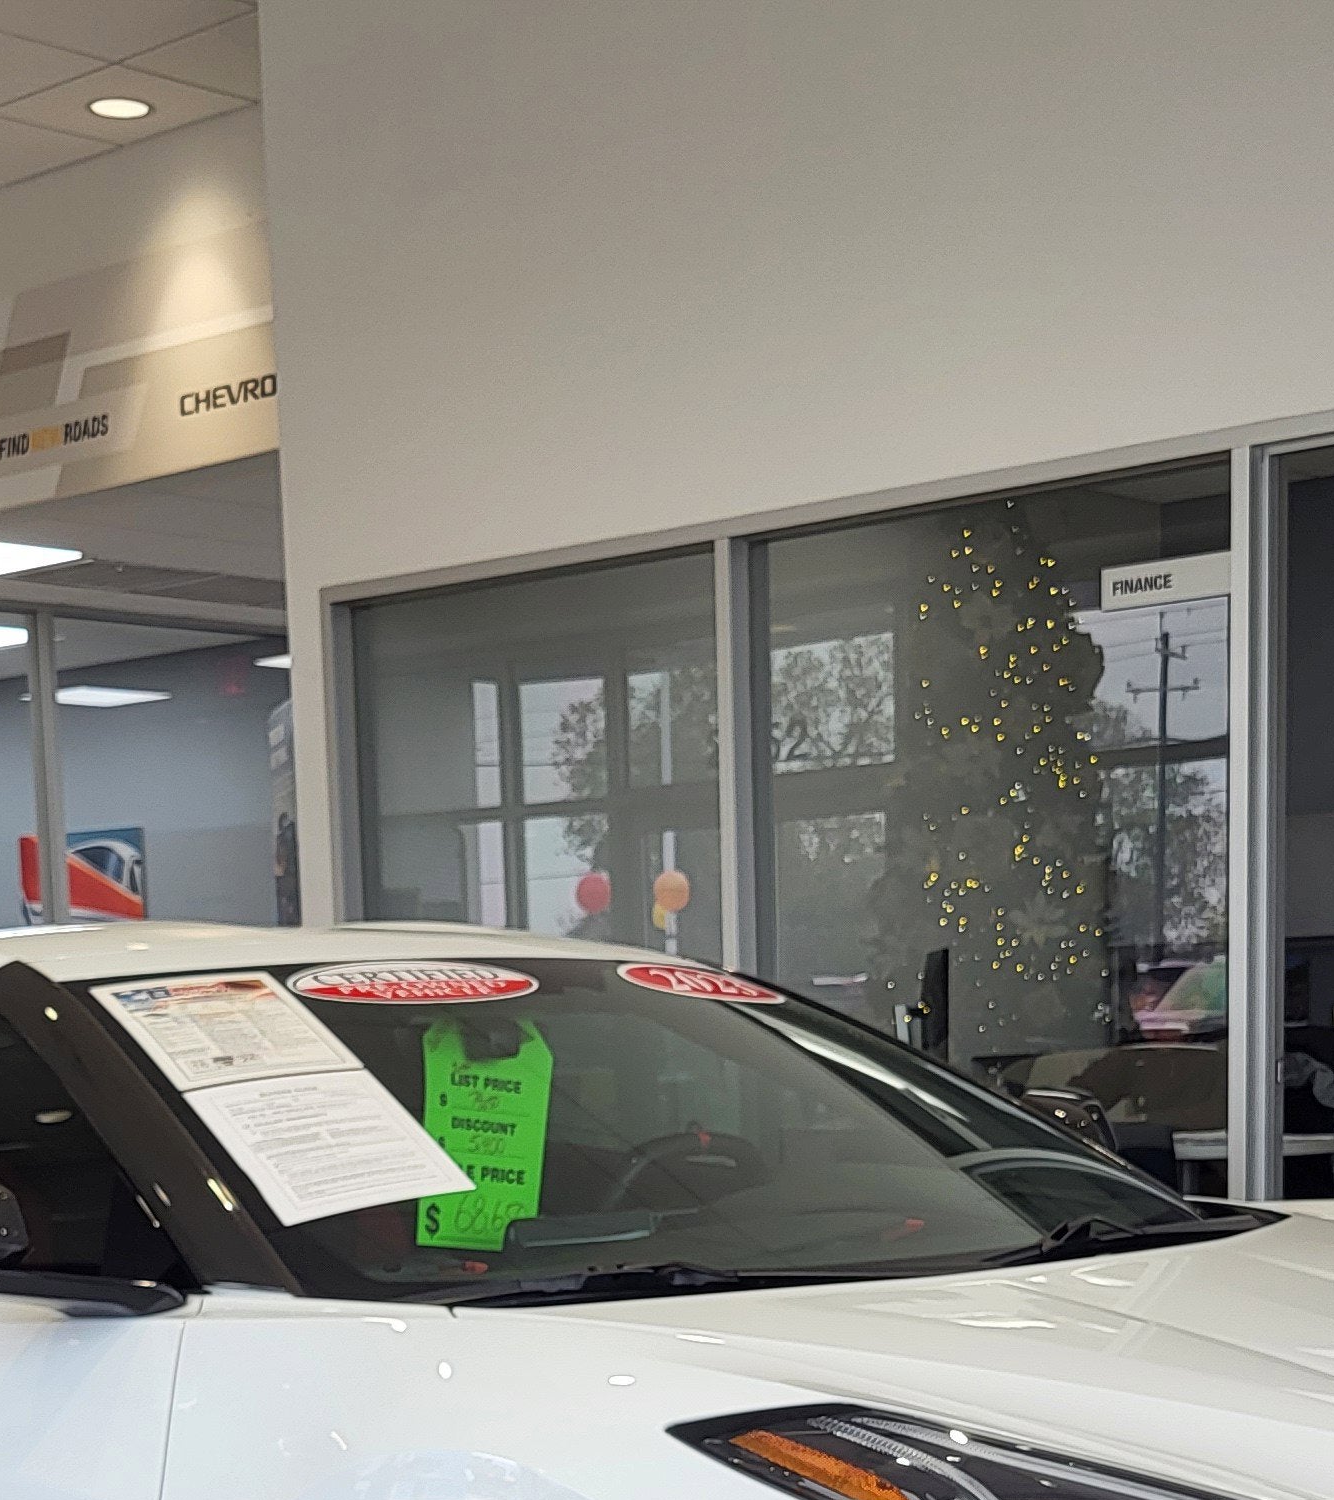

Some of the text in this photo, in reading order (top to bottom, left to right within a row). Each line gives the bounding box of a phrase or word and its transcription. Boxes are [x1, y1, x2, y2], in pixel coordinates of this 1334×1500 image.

[0, 432, 30, 460] FIND
[63, 415, 109, 445] ROADS
[1112, 573, 1173, 597] FINANCE
[313, 968, 499, 986] CERTIFIED
[451, 1072, 522, 1094] LIST PRICE
[451, 1116, 518, 1136] DISCOUNT
[481, 1166, 526, 1185] PRICE
[425, 1203, 442, 1240] $
